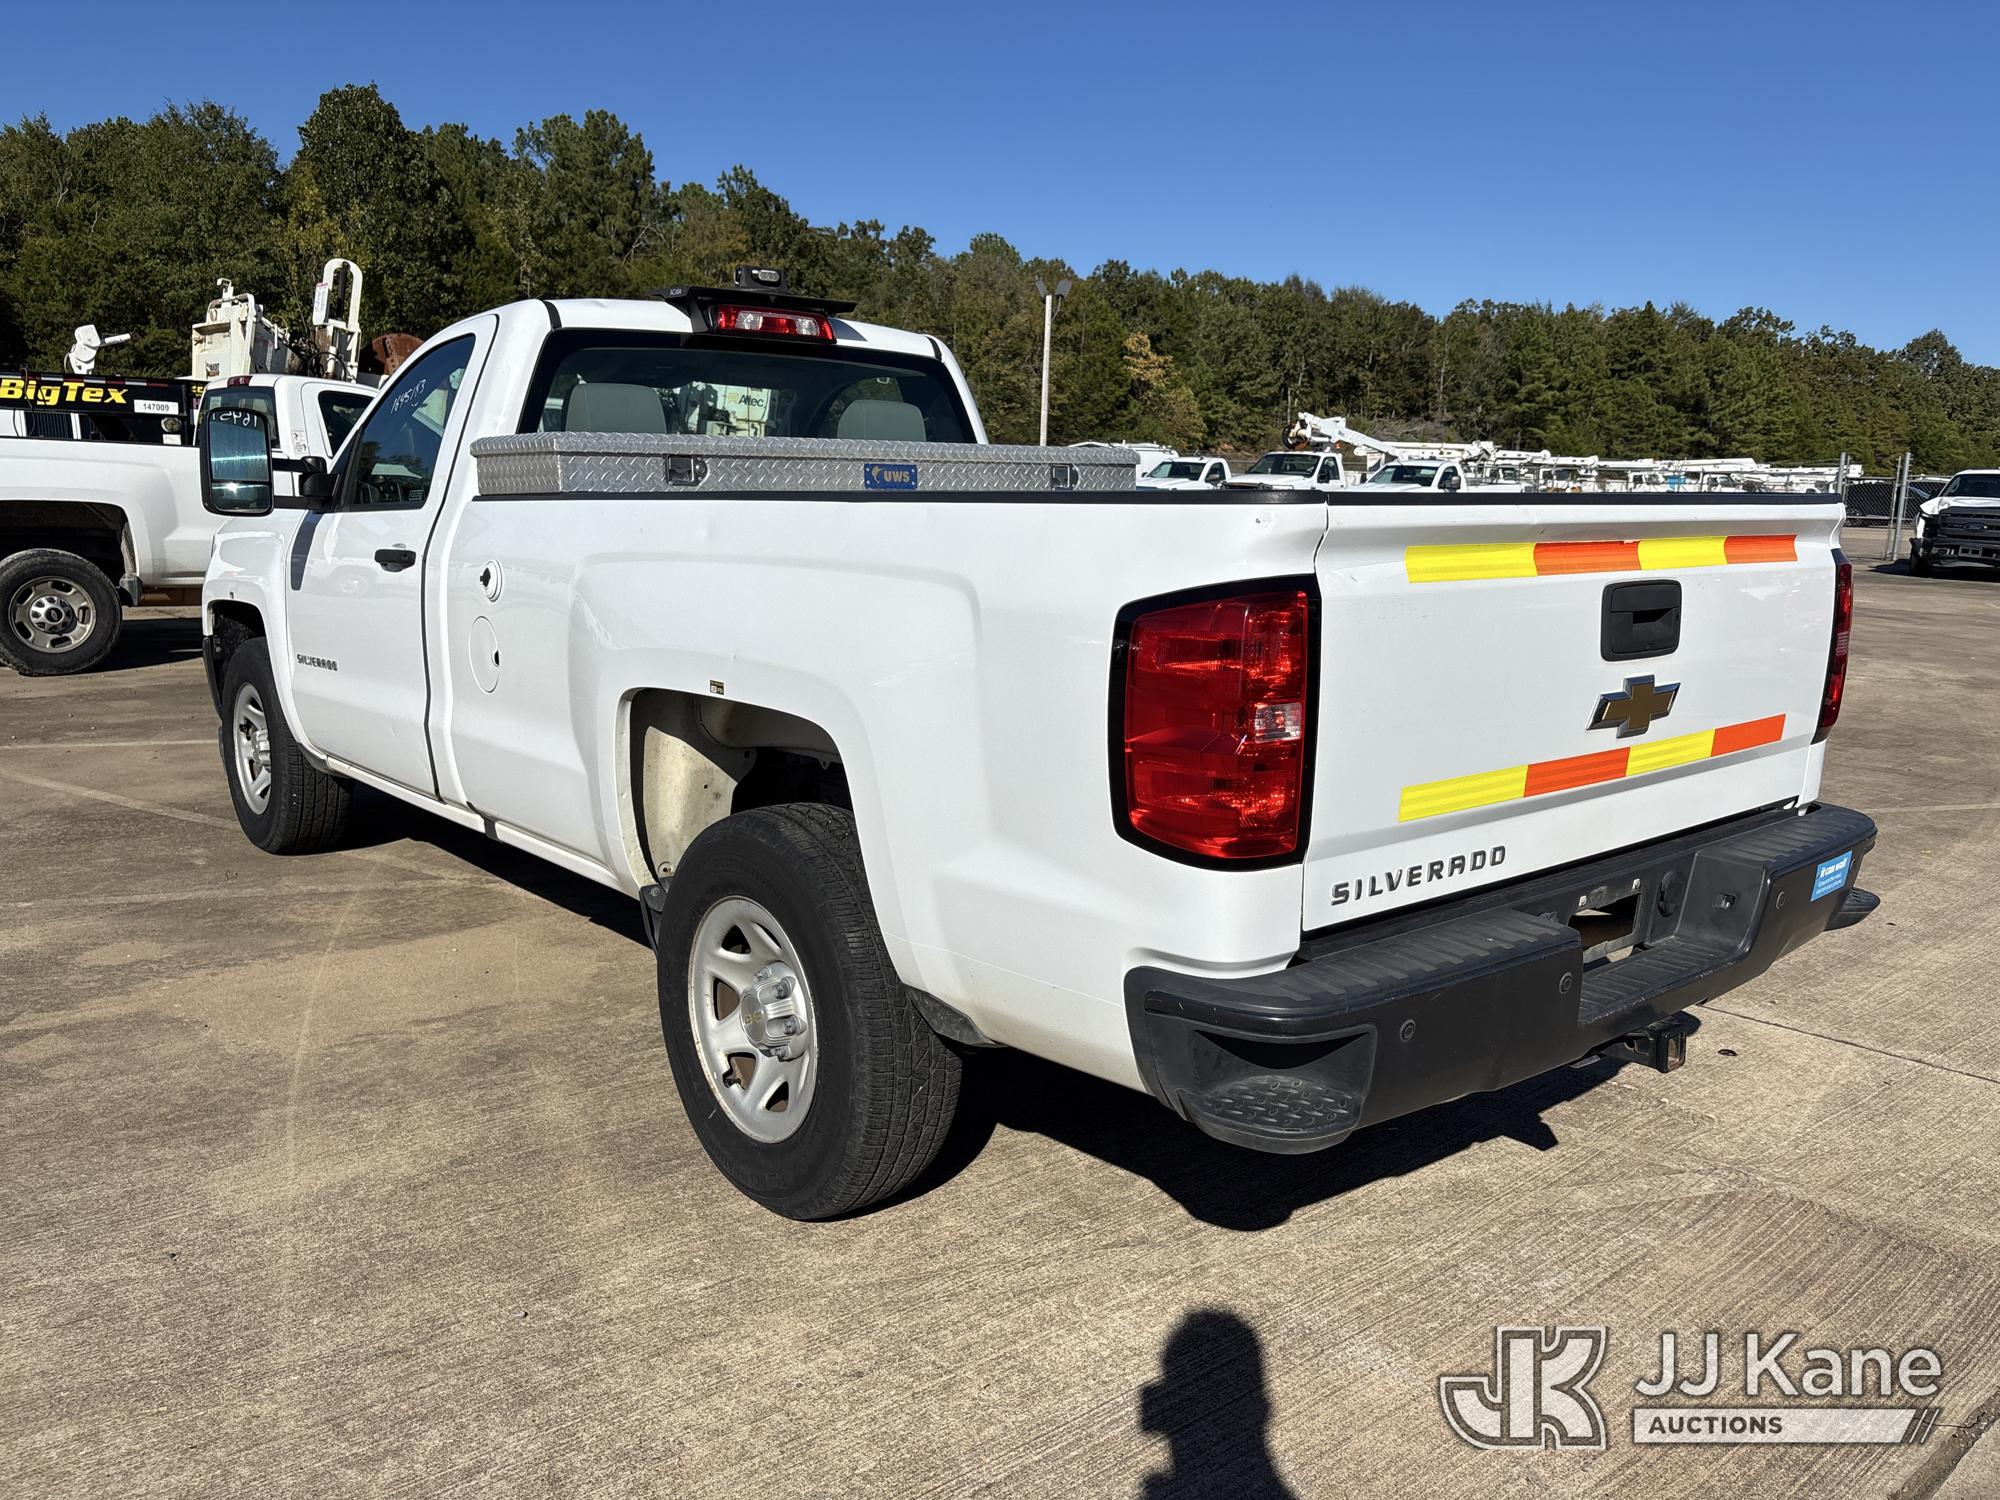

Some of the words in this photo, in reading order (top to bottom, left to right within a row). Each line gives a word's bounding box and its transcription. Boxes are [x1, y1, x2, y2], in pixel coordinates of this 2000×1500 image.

[0, 379, 128, 406] BigTex
[143, 403, 170, 412] 147009
[883, 470, 910, 483] UWS
[1331, 845, 1506, 906] SILVERADO
